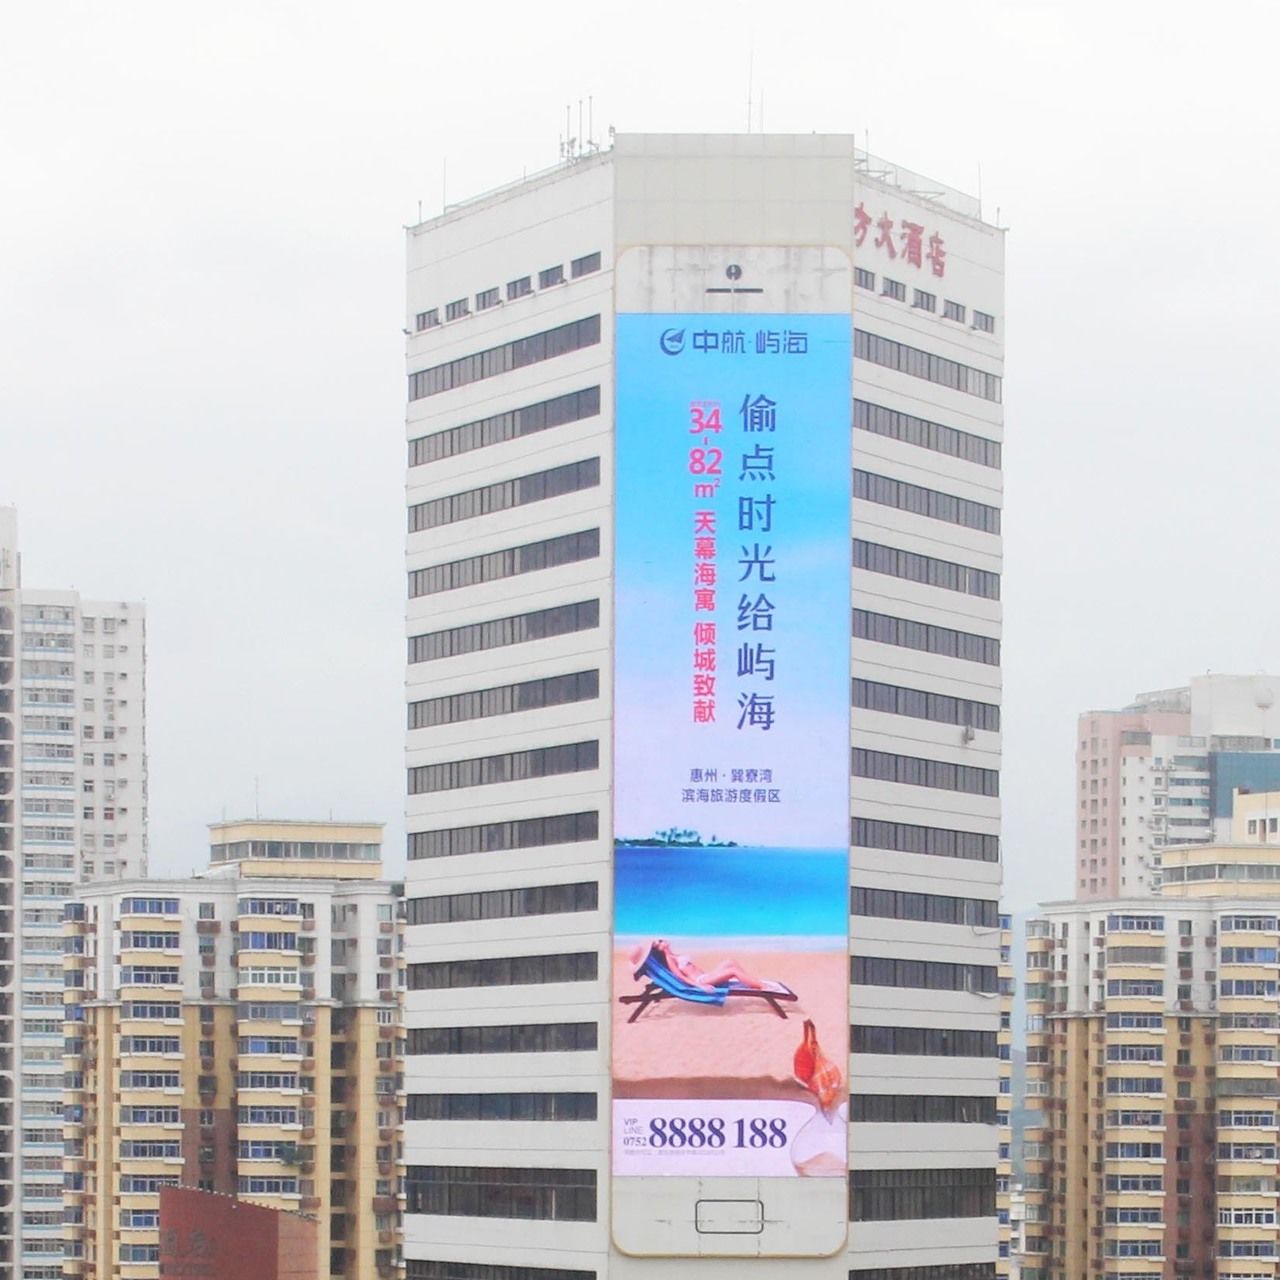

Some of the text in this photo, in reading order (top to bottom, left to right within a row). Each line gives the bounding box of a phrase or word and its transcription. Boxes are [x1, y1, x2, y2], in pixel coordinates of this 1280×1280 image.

[736, 393, 777, 731] 偷点时光给屿海
[682, 788, 781, 803] 滨海旅游度假区
[623, 1117, 788, 1149] 0752 8888 188
